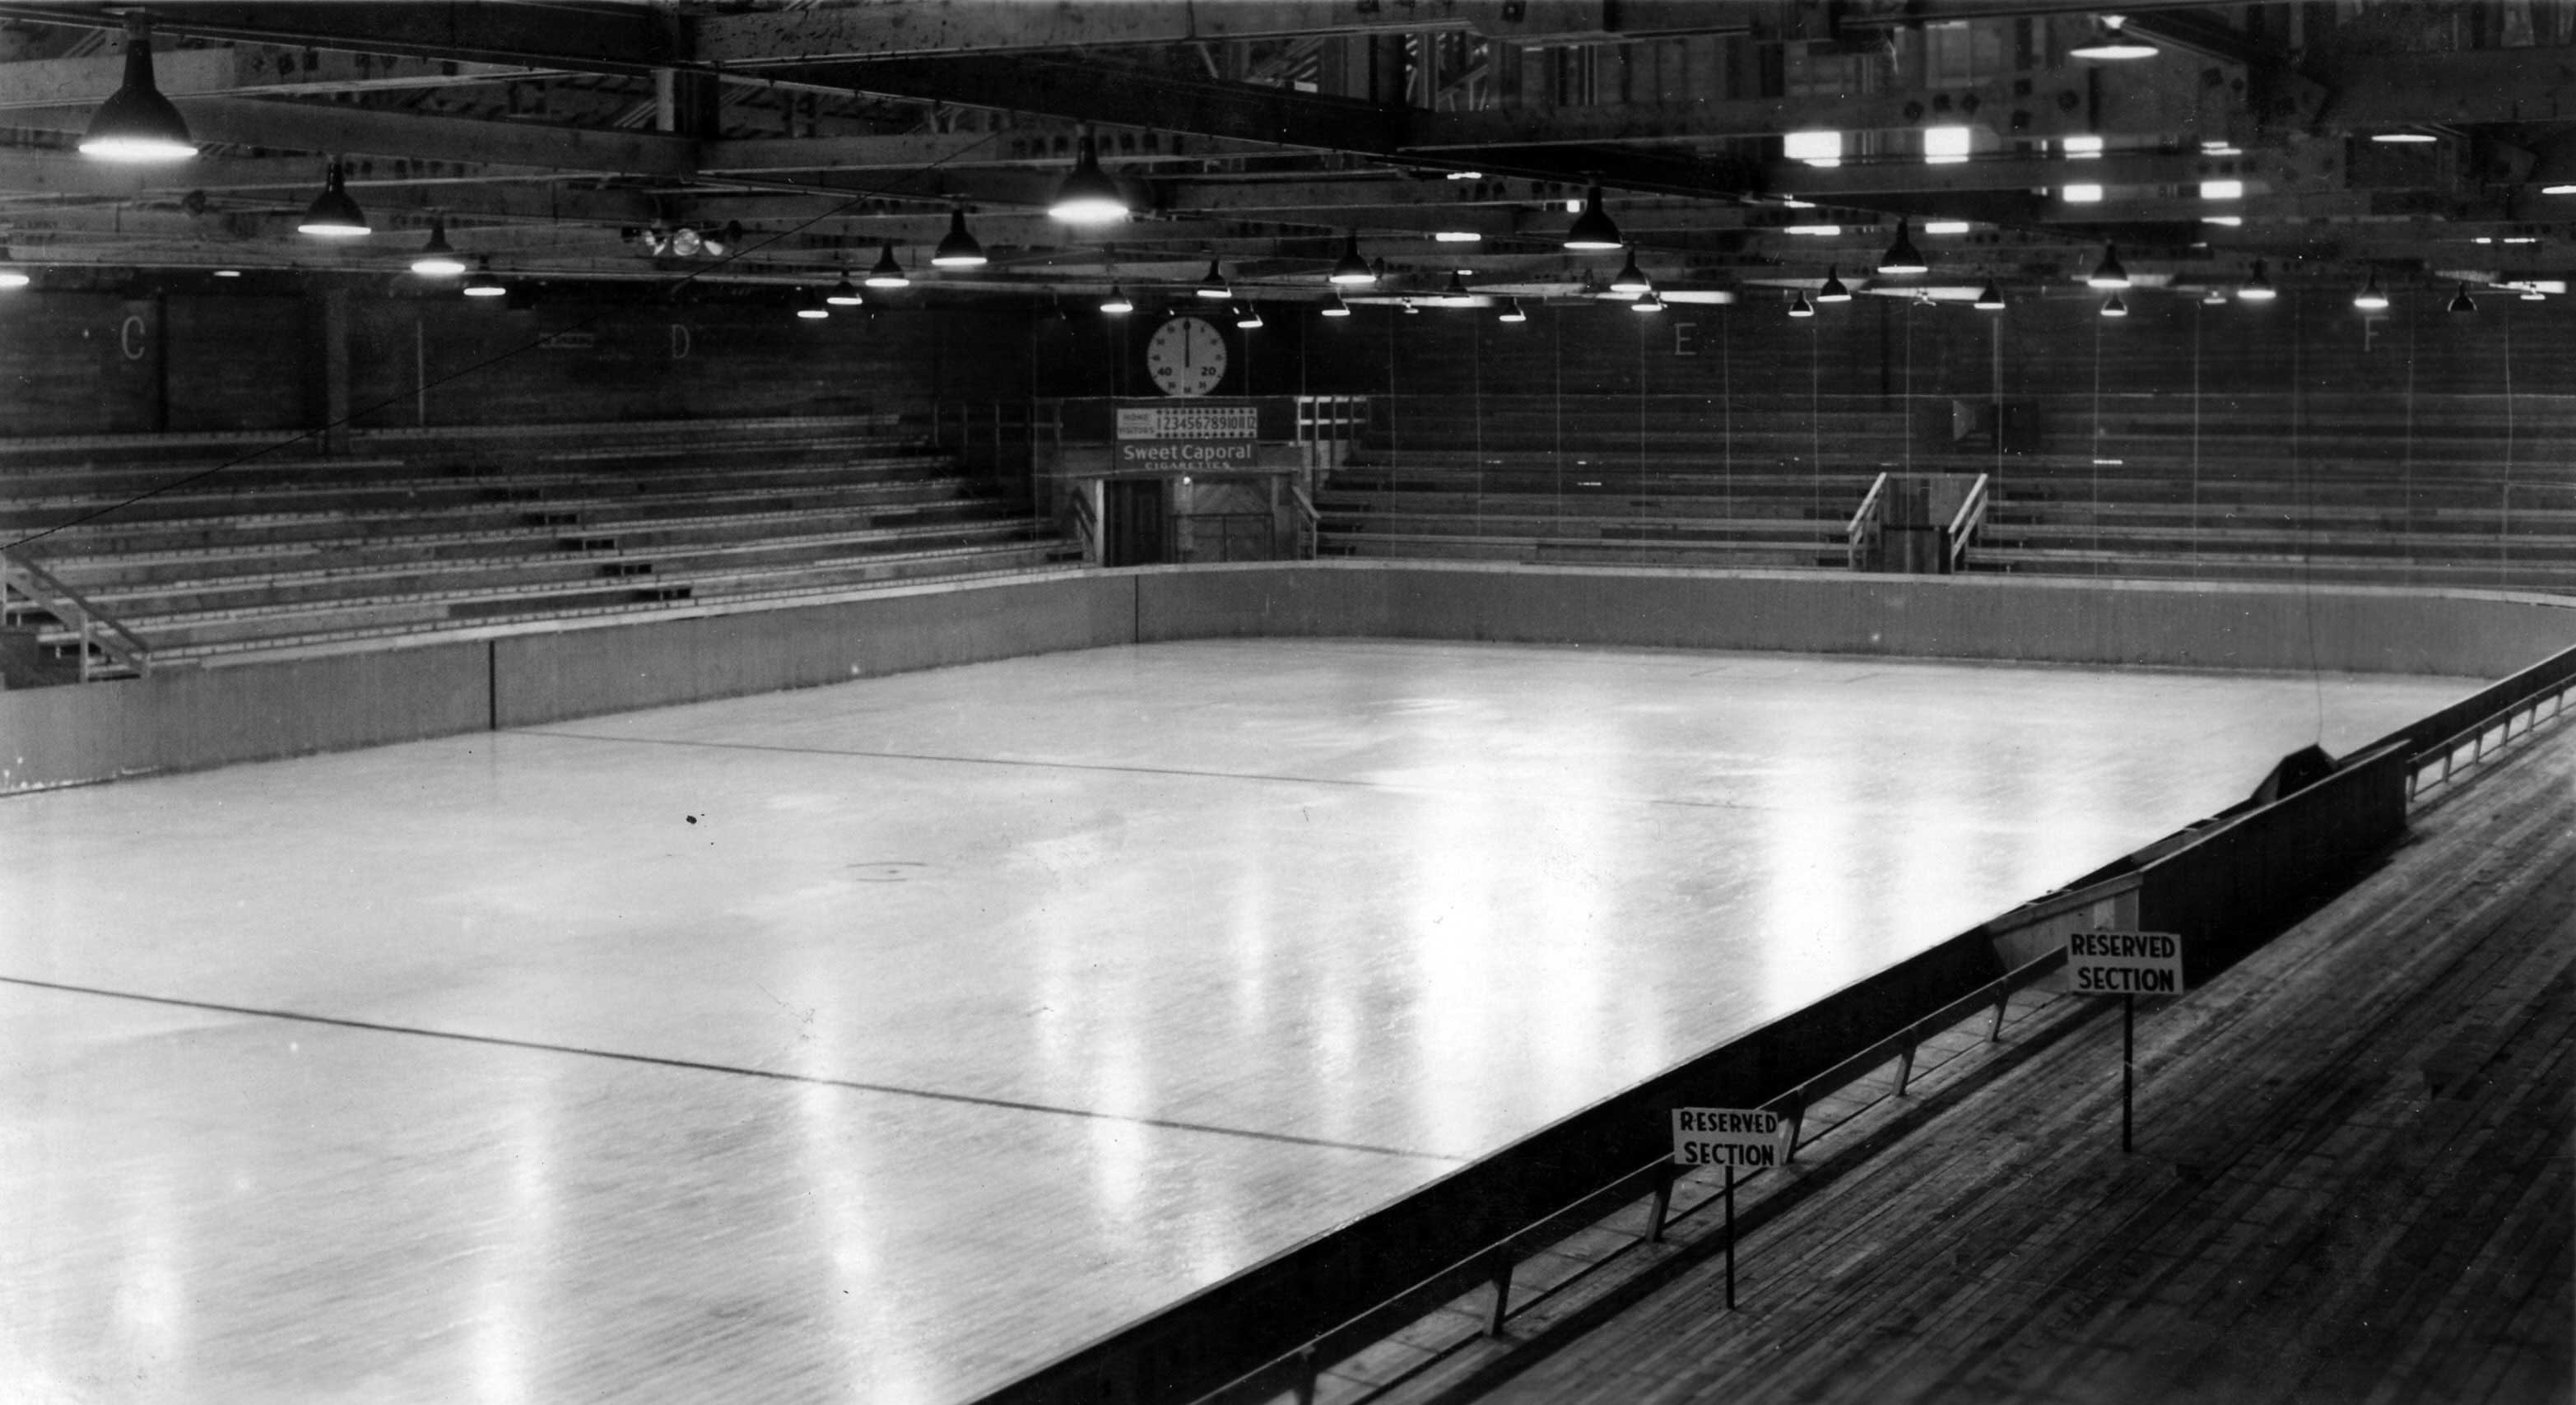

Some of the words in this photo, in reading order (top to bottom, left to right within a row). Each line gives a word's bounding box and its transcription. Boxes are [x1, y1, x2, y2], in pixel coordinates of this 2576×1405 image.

[122, 316, 145, 360] C
[672, 324, 690, 360] D
[1674, 323, 1696, 355] E
[2364, 315, 2389, 351] F
[1158, 366, 1172, 376] 40
[1201, 366, 1216, 376] 20
[1123, 444, 1178, 460] Sweet
[1182, 444, 1251, 461] Caporal
[2071, 933, 2175, 958] RESERVED
[2077, 966, 2174, 992] SECTION
[1680, 1111, 1777, 1133] RESERVED
[1684, 1142, 1774, 1166] SECTION
